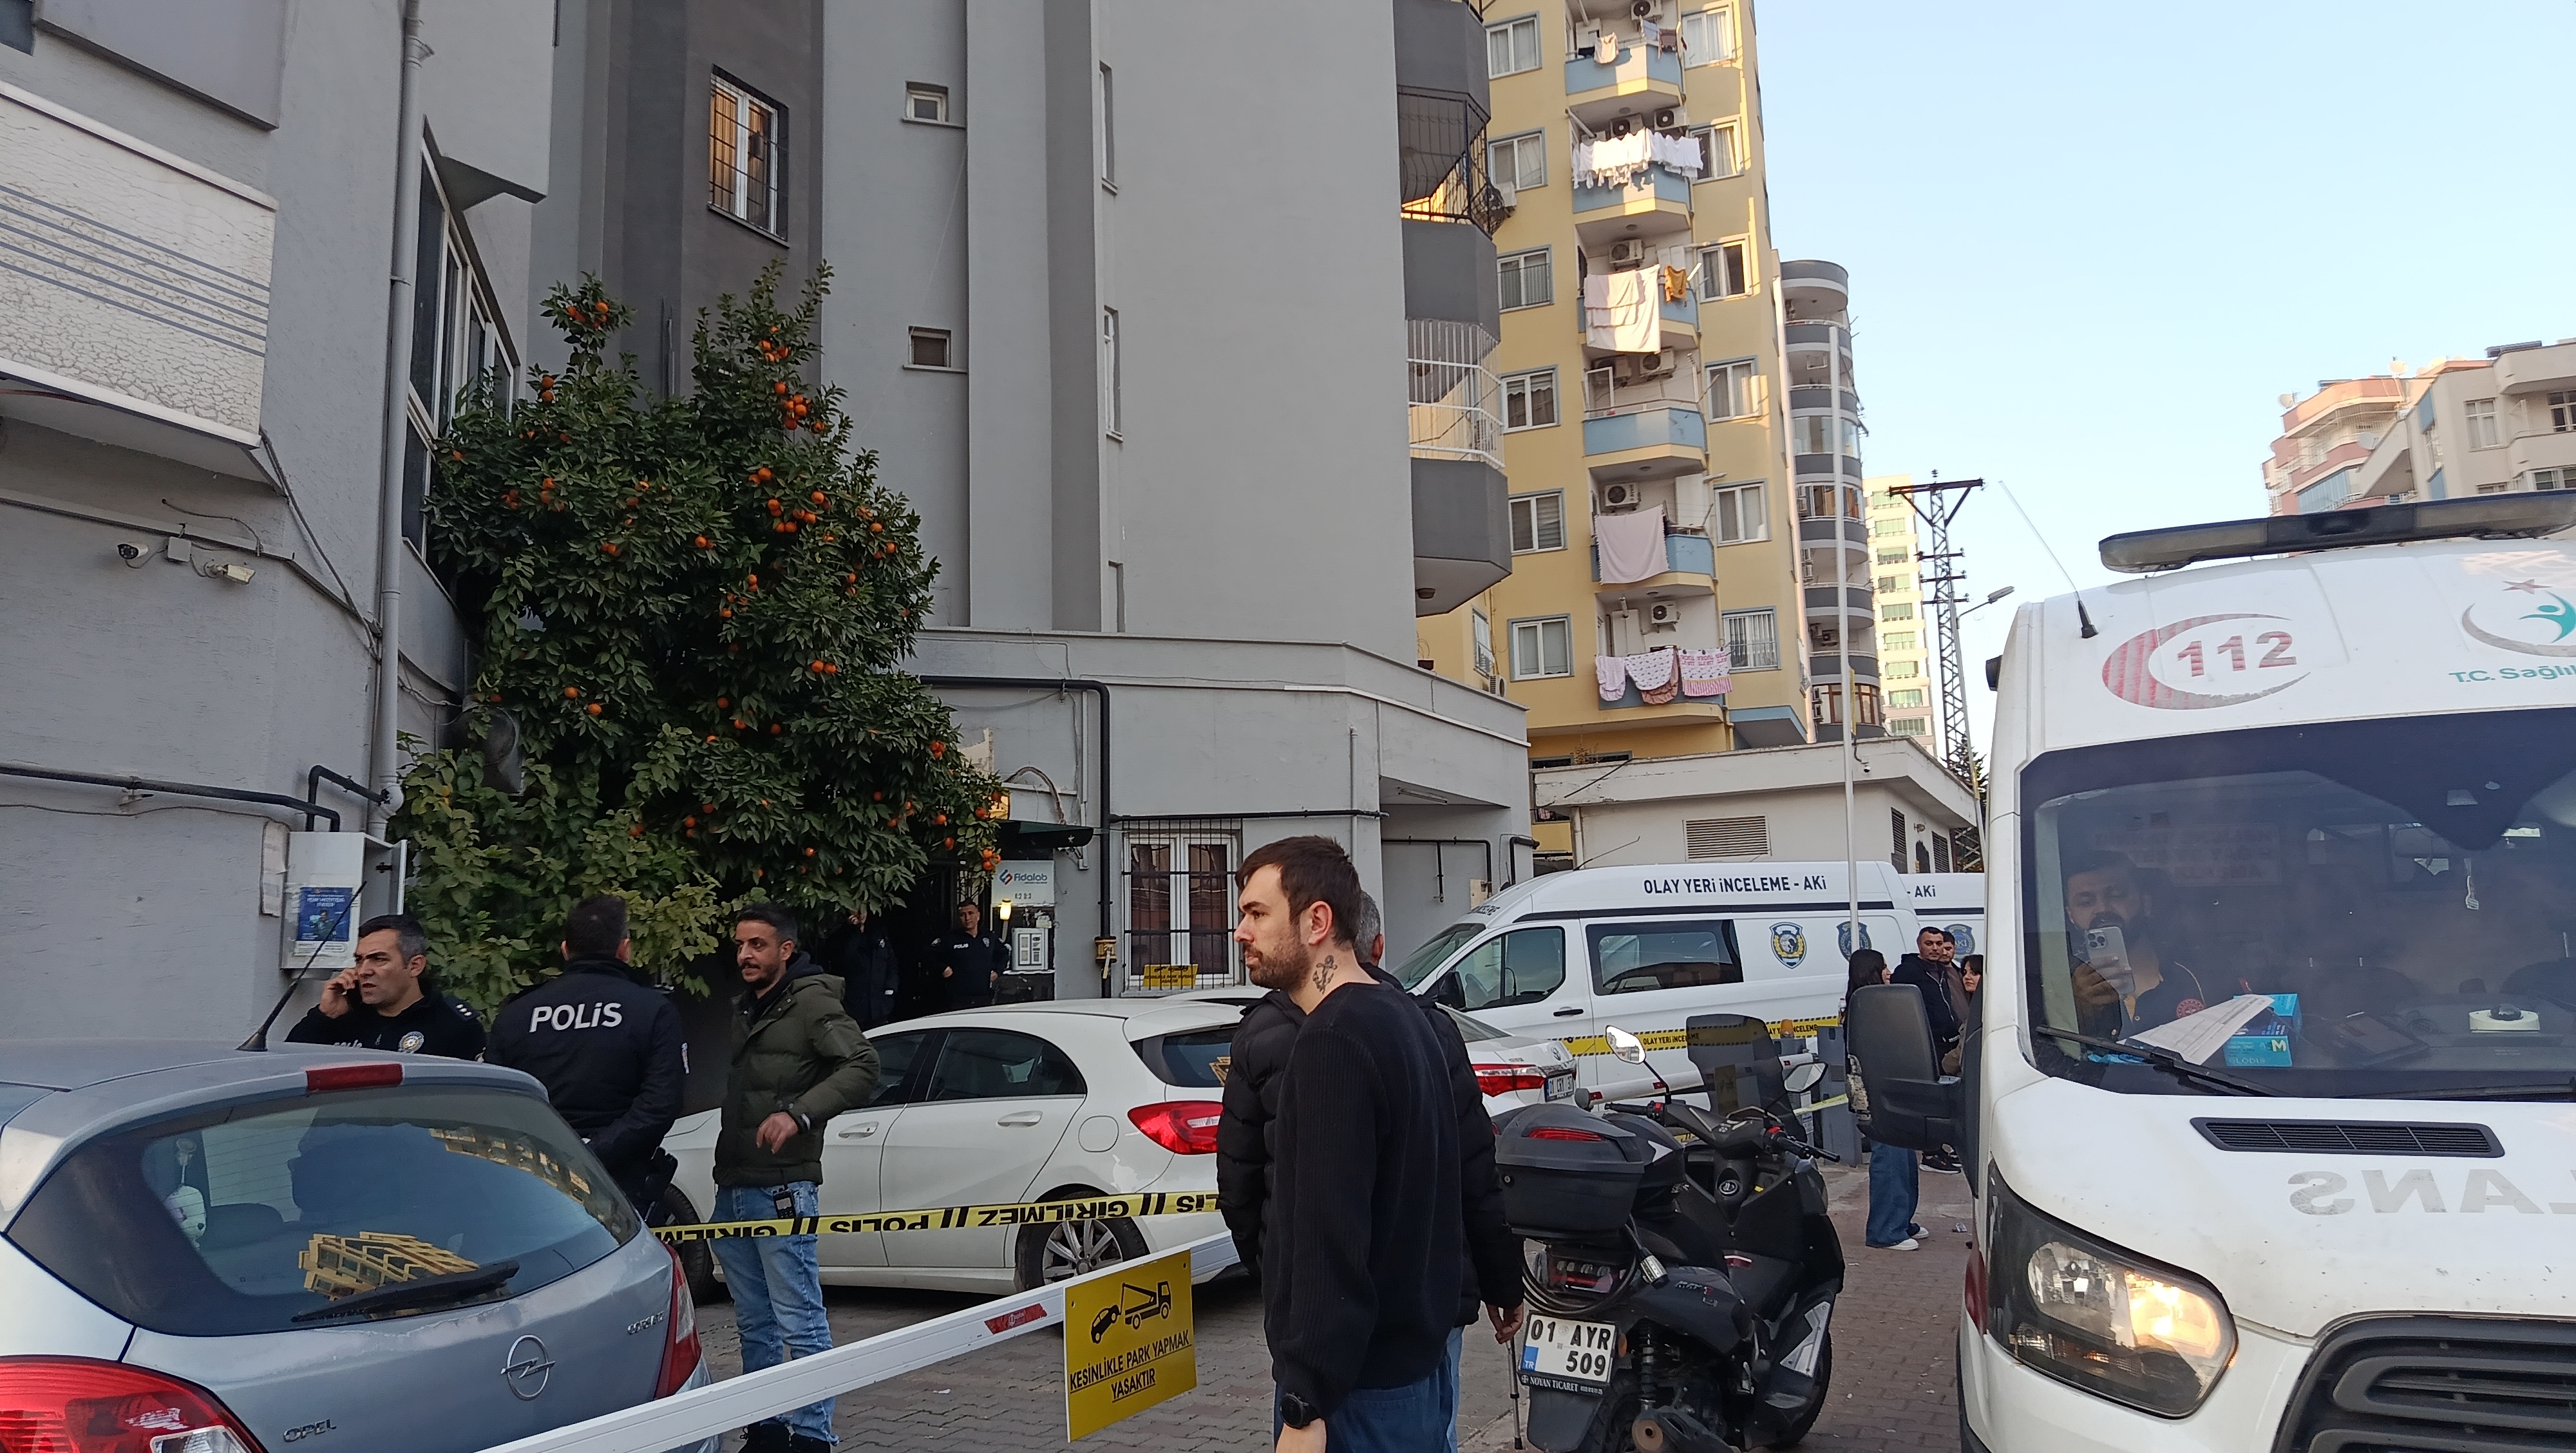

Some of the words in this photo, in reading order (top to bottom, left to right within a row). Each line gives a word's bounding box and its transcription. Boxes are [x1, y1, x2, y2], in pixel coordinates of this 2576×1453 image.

[2177, 631, 2297, 677] 112
[2448, 670, 2496, 682] T.C.
[1014, 873, 1048, 881] Fidalab
[1643, 879, 1680, 893] OLAY
[2271, 1040, 2287, 1052] M
[1531, 1320, 1556, 1342] 01
[1570, 1325, 1611, 1350] AYR
[1070, 1354, 1124, 1391] KESİNLİKLE
[1127, 1344, 1151, 1369] PARK
[1152, 1329, 1189, 1357] YAPMAK
[1524, 1360, 1535, 1369] TR
[1566, 1351, 1606, 1376] 509
[1111, 1367, 1156, 1400] YASAKTIR
[1530, 1376, 1551, 1389] NOYAN
[283, 1419, 337, 1443] OPEL
